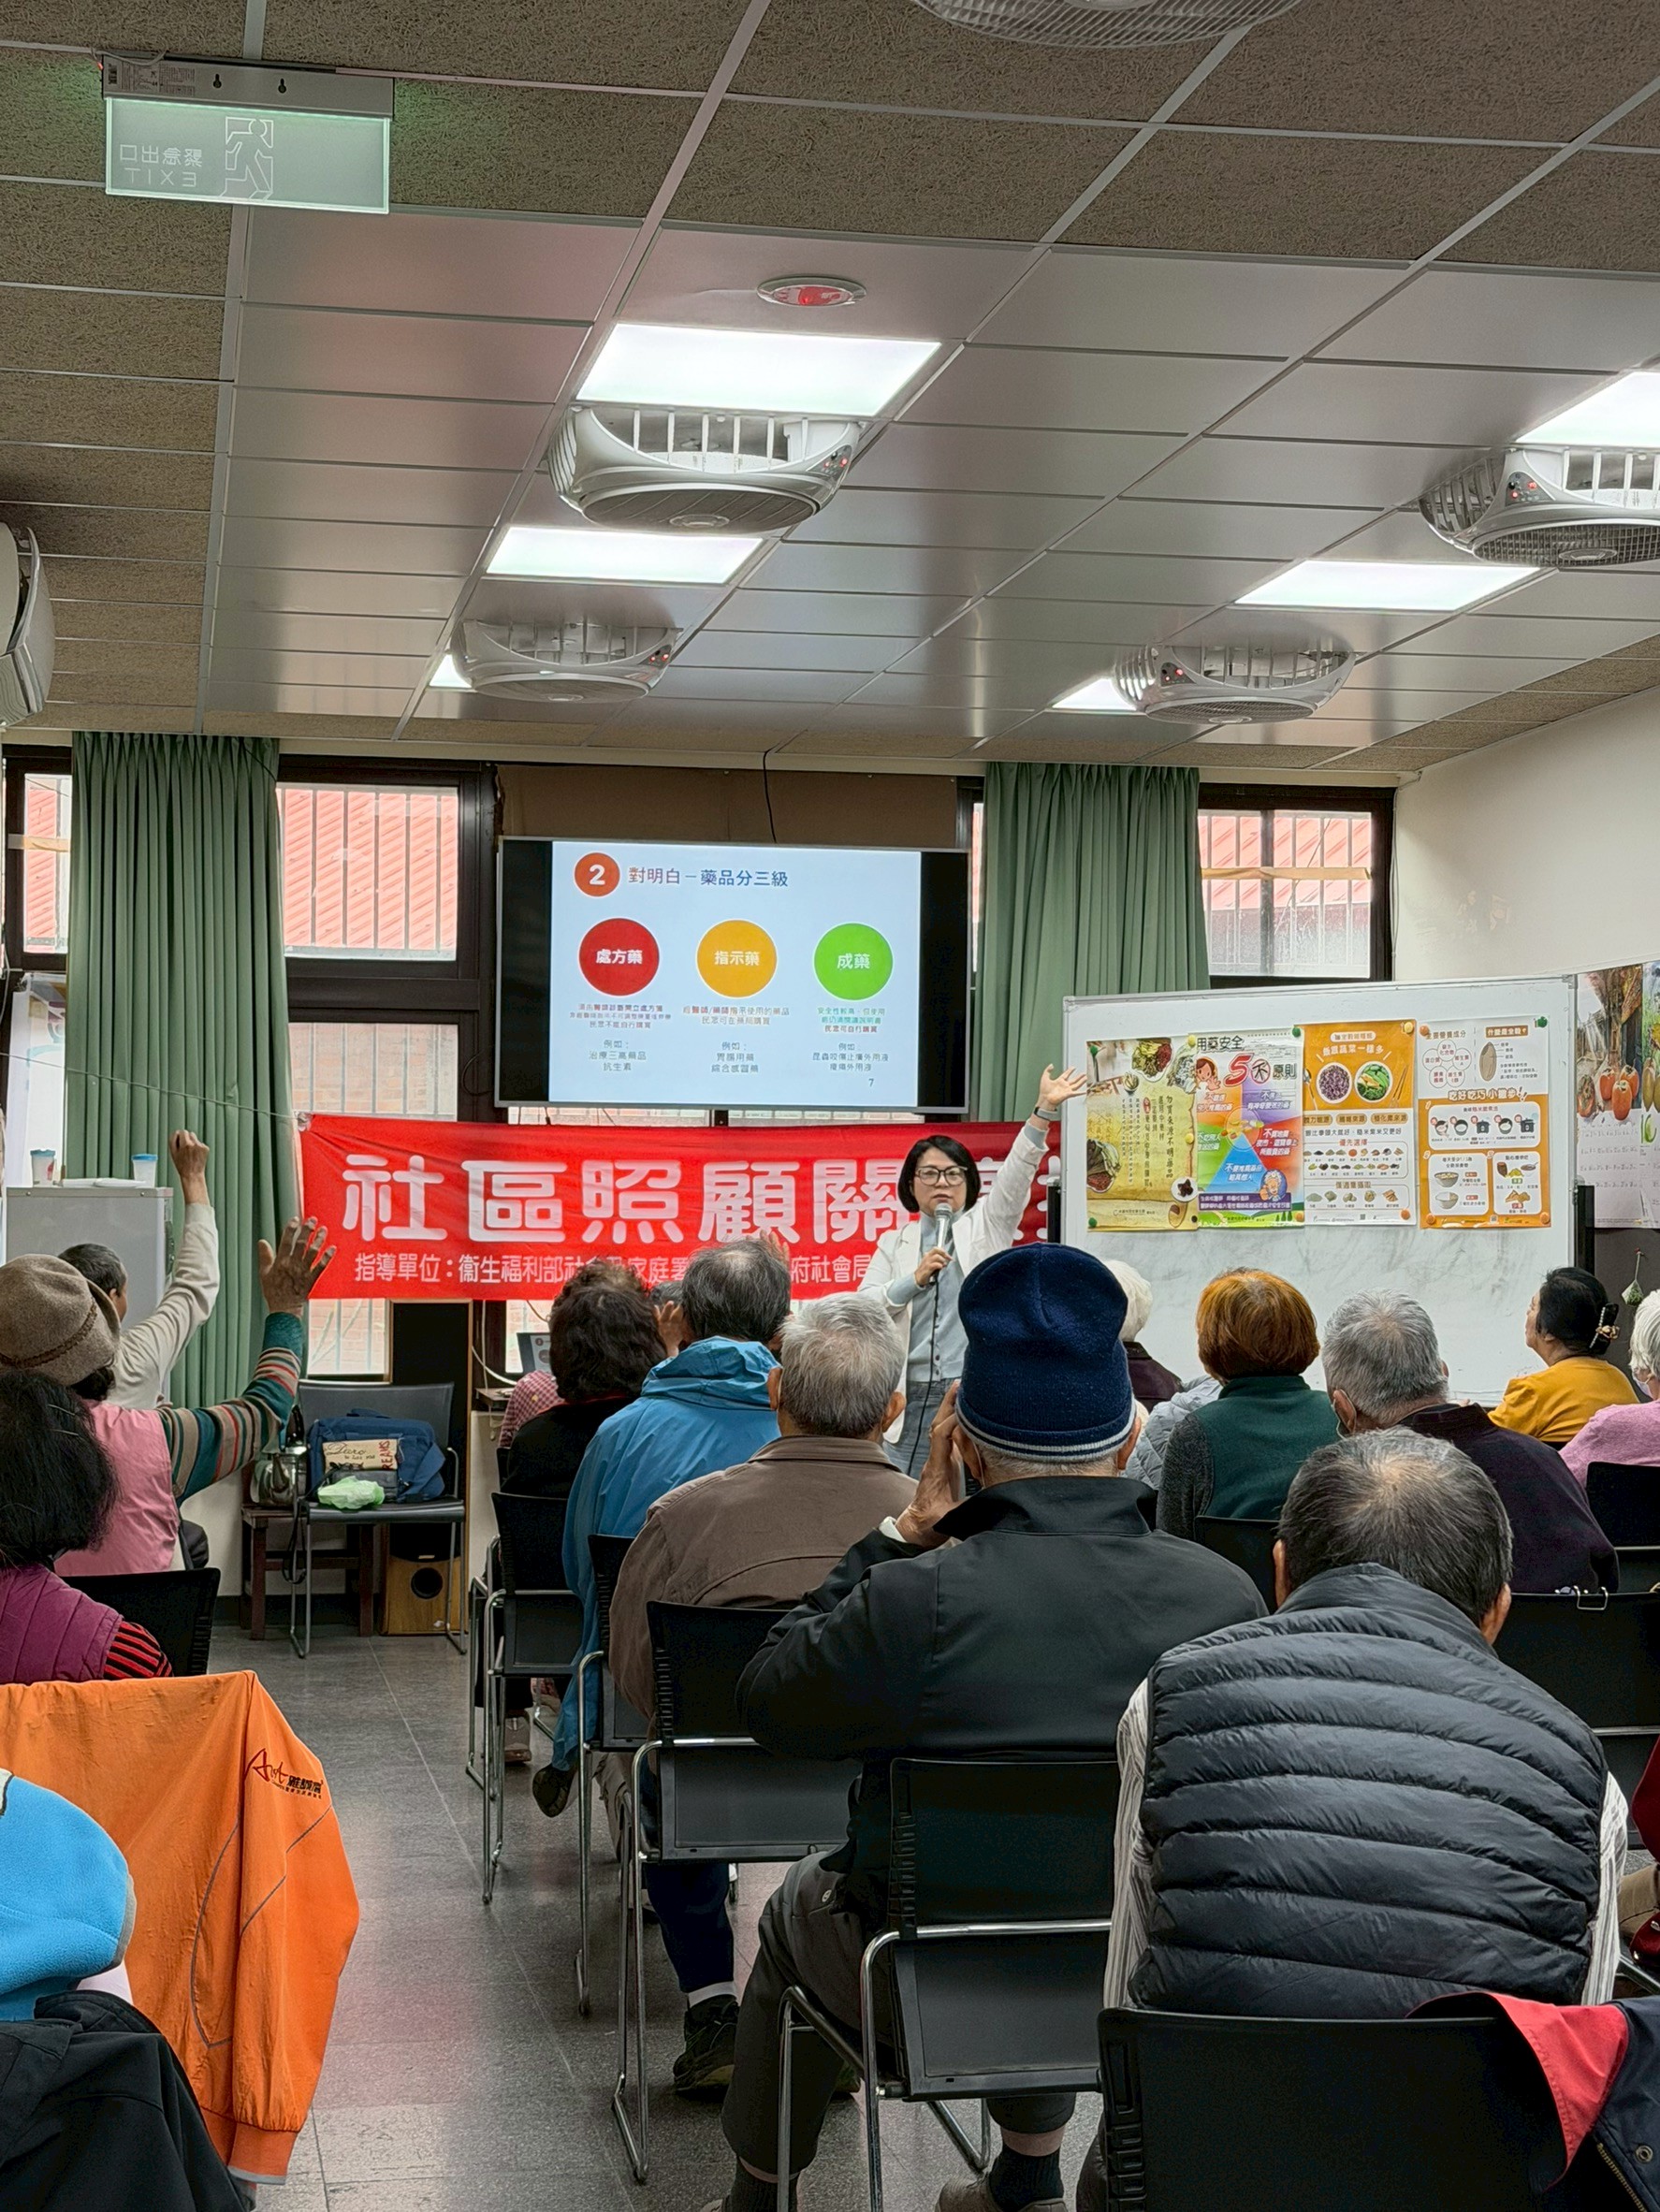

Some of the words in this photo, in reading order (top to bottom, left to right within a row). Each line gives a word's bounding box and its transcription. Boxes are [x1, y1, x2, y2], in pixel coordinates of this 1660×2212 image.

[590, 865, 606, 886] 2
[595, 949, 643, 965] 處方藥
[714, 950, 761, 966] 指示藥
[837, 953, 871, 969] 成藥
[603, 1062, 633, 1071] 抗生素
[868, 1078, 875, 1087] 7
[342, 1154, 1060, 1244] 社區照顧關
